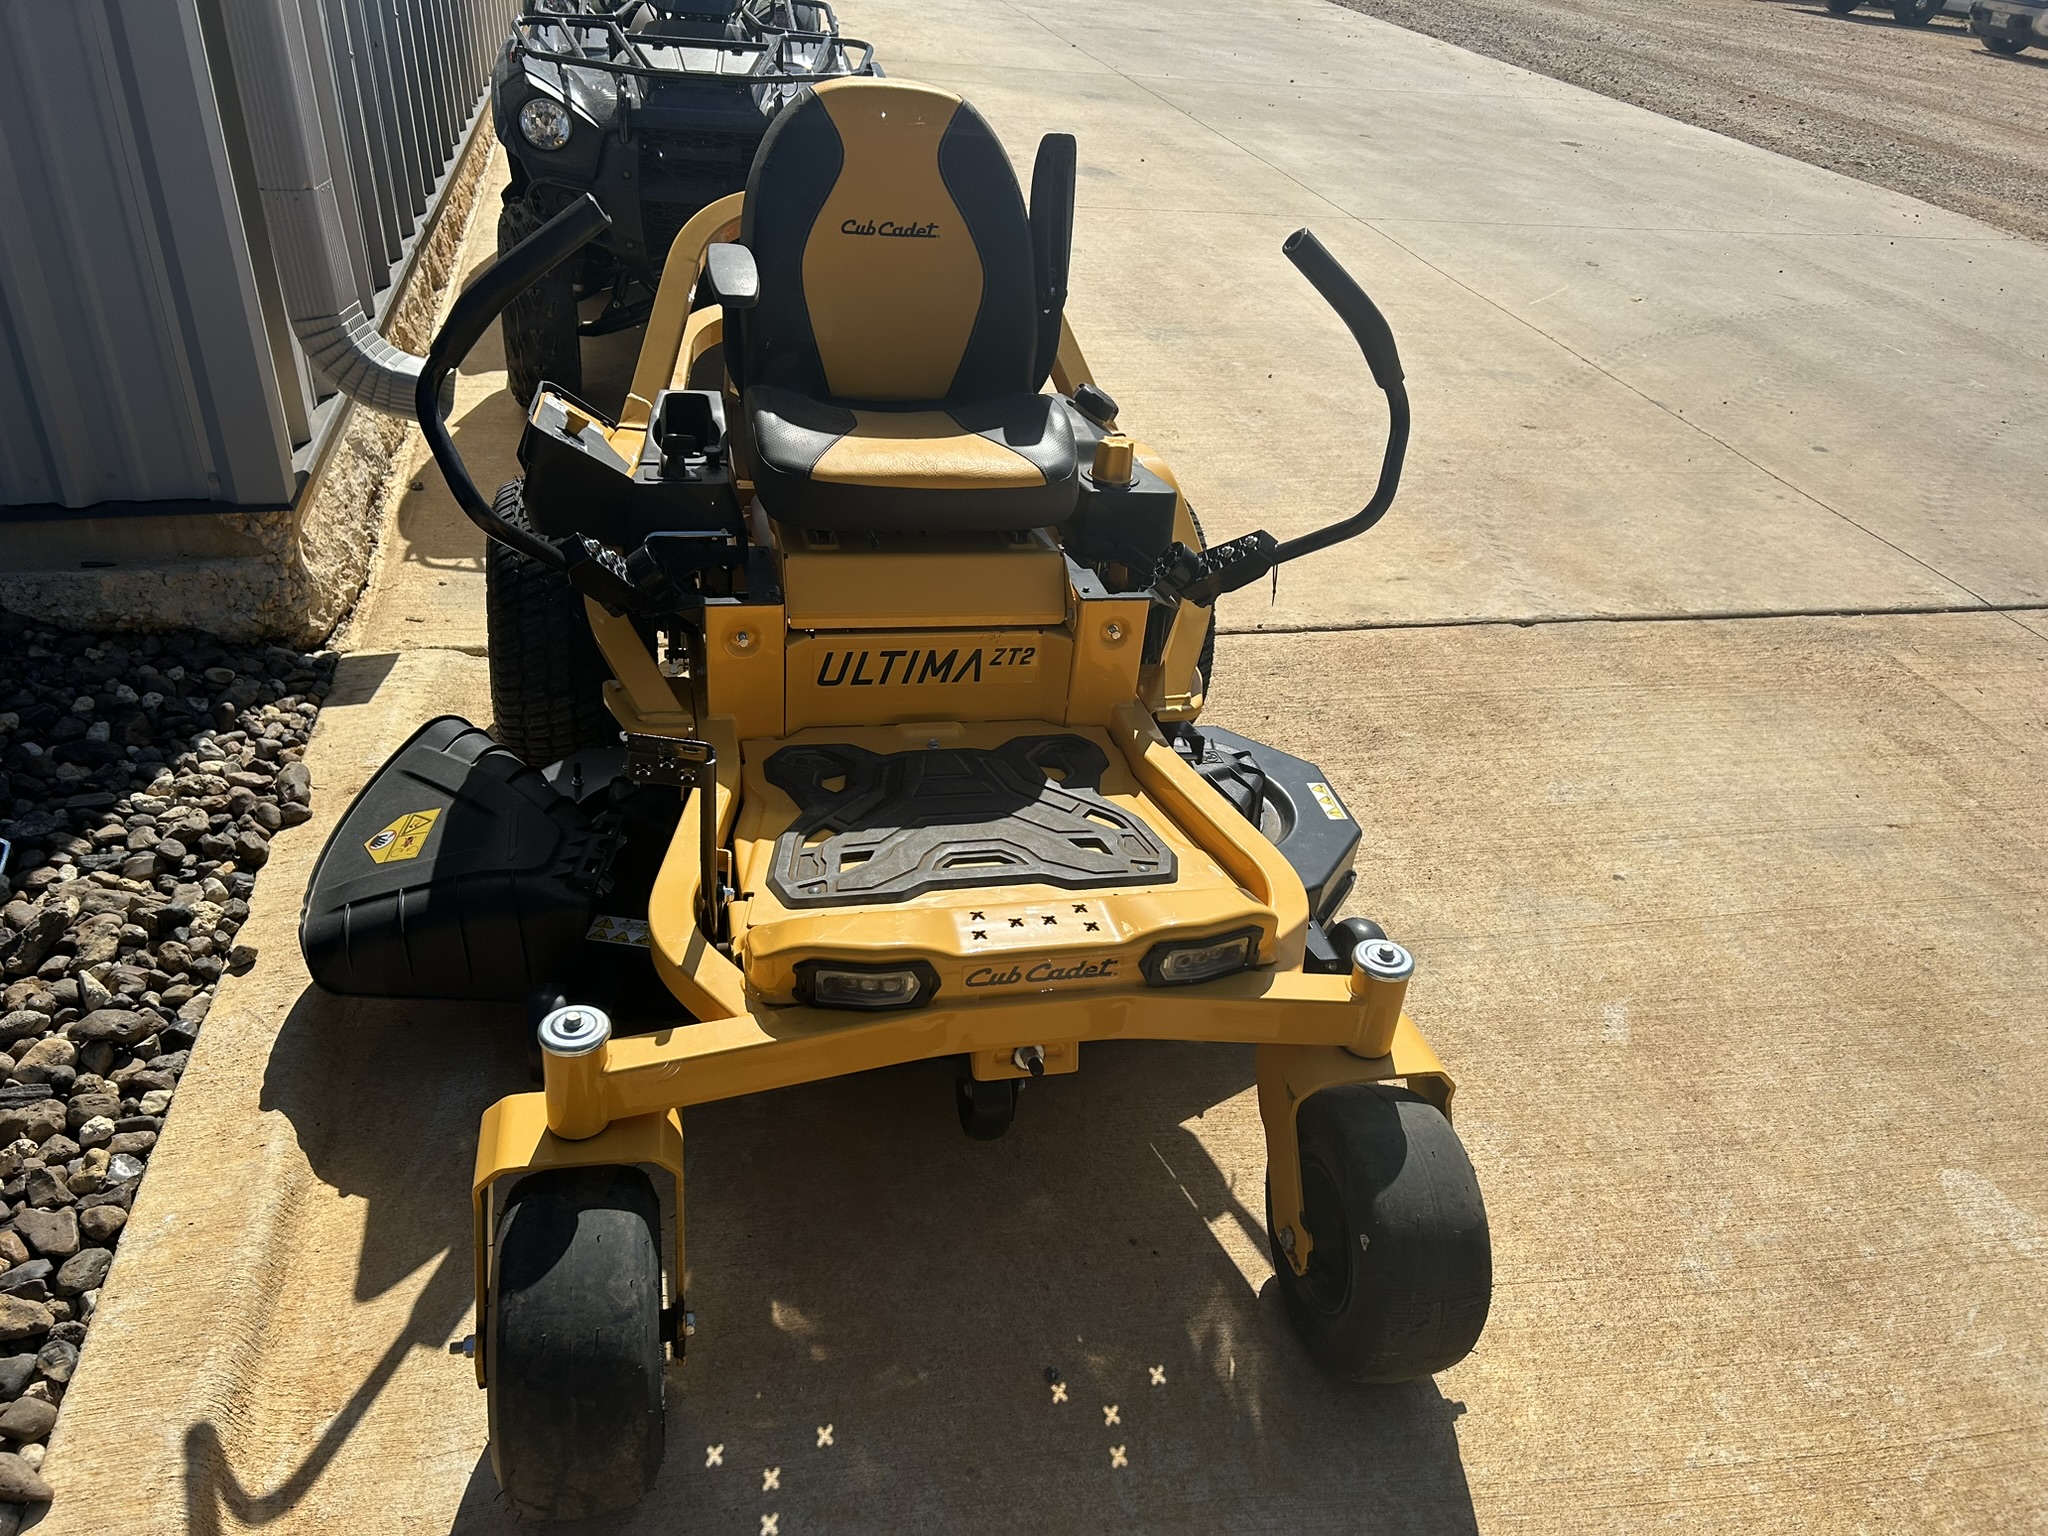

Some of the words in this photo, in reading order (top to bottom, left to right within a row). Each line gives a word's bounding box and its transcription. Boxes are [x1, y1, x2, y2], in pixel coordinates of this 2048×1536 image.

[841, 219, 876, 236] Cub
[878, 221, 939, 239] Cadet
[816, 649, 983, 687] ULTIMA
[989, 647, 1036, 667] ZT2
[965, 966, 1022, 988] Cub
[1025, 958, 1118, 983] Cadet
